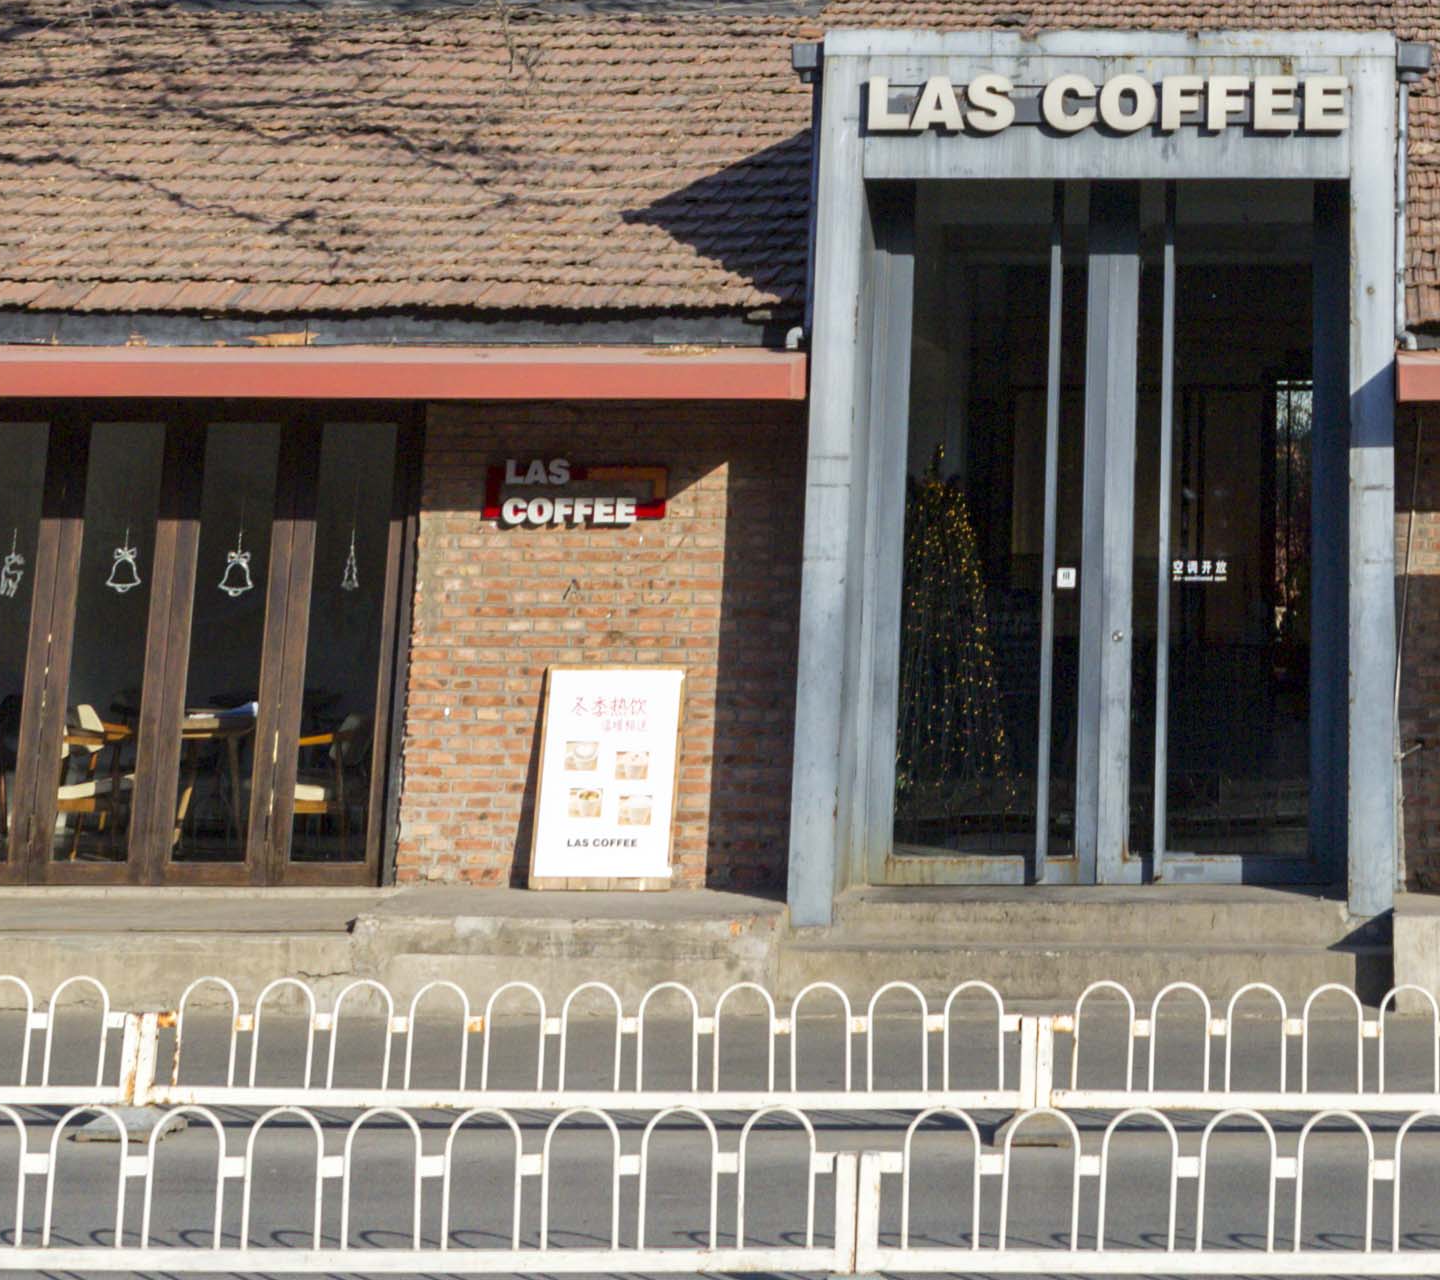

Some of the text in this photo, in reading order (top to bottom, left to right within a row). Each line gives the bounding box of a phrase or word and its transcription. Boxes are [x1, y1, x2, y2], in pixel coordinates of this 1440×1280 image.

[868, 74, 1350, 133] LAS COFFEE
[505, 458, 571, 485] LAS
[502, 497, 637, 524] COFFEE
[1172, 559, 1228, 575] 空调开放
[570, 696, 648, 718] 冬季热饮
[567, 838, 638, 848] LAS COFFEE
